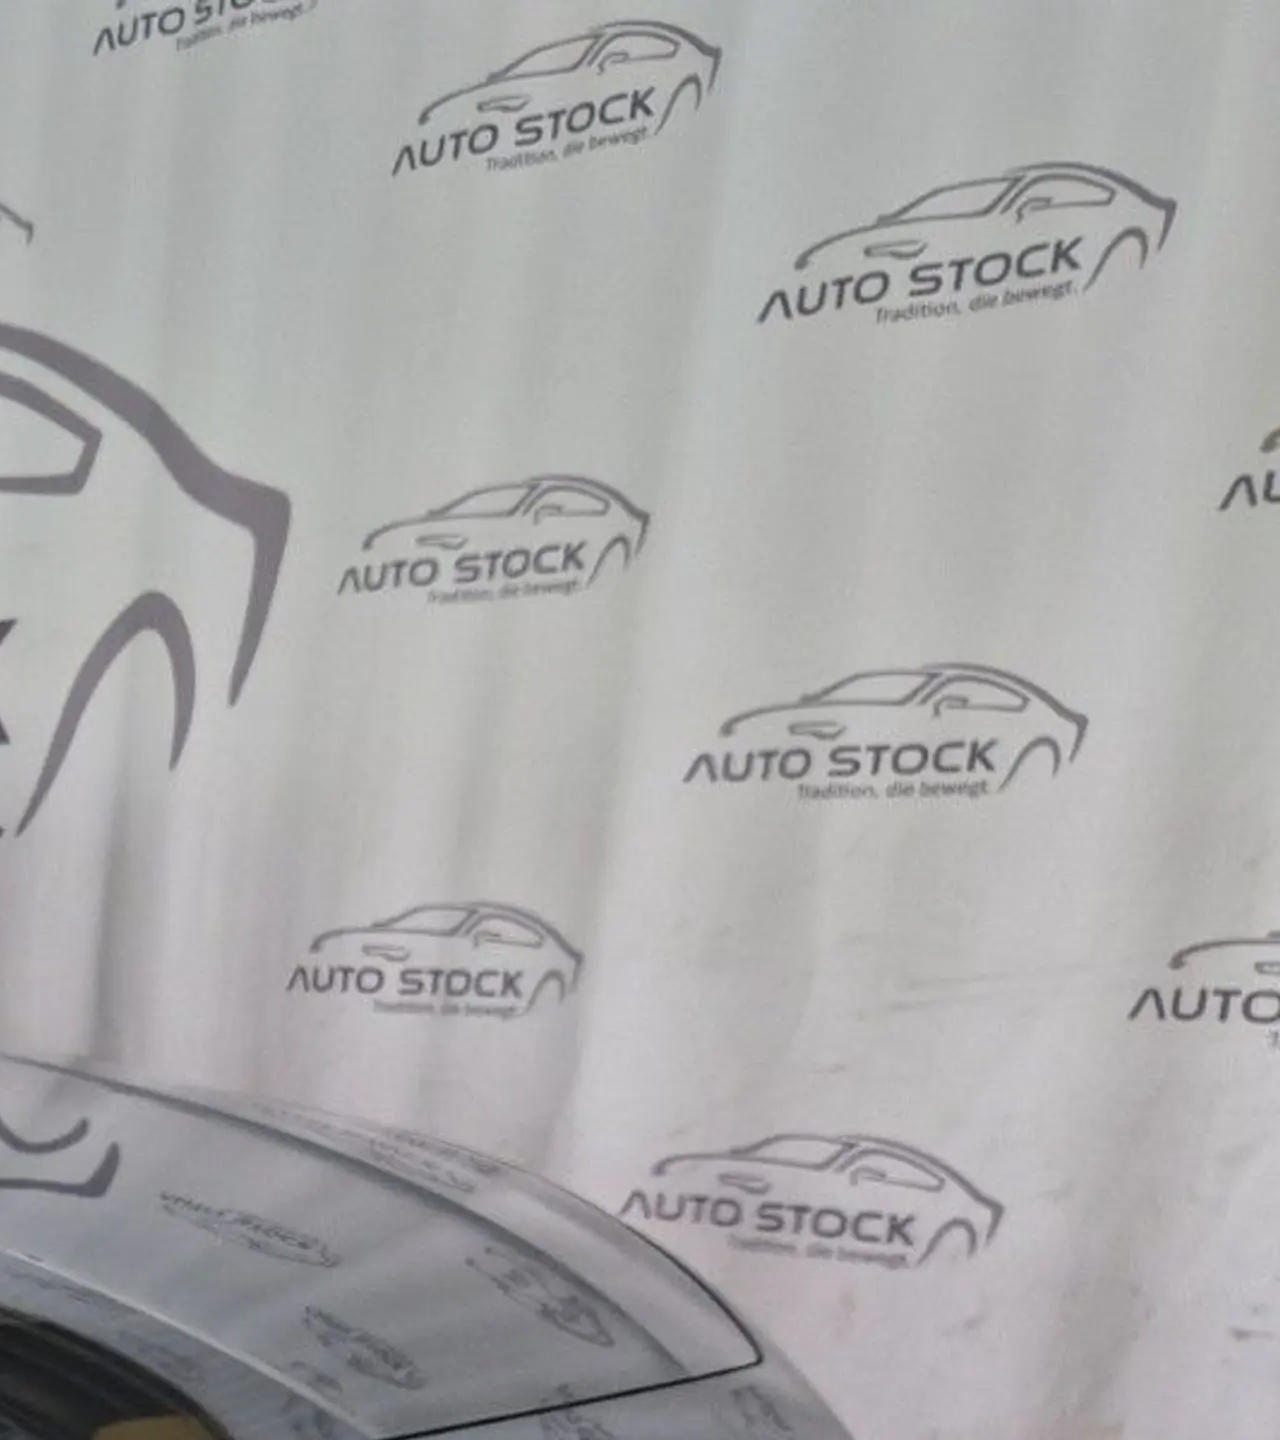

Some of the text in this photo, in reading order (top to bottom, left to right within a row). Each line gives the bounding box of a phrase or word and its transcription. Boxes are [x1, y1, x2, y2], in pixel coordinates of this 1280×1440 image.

[93, 7, 186, 57] AUTO
[392, 85, 656, 178] AUTO STOCK
[757, 235, 1085, 325] AUTO STOCK
[337, 556, 440, 596] AUTO
[453, 541, 588, 584] STOCK
[682, 737, 1000, 784] AUTO STOCK
[285, 965, 524, 1000] AUTO STOCK
[1126, 985, 1280, 1026] AUTO
[619, 1188, 917, 1248] AUTO STOCK
